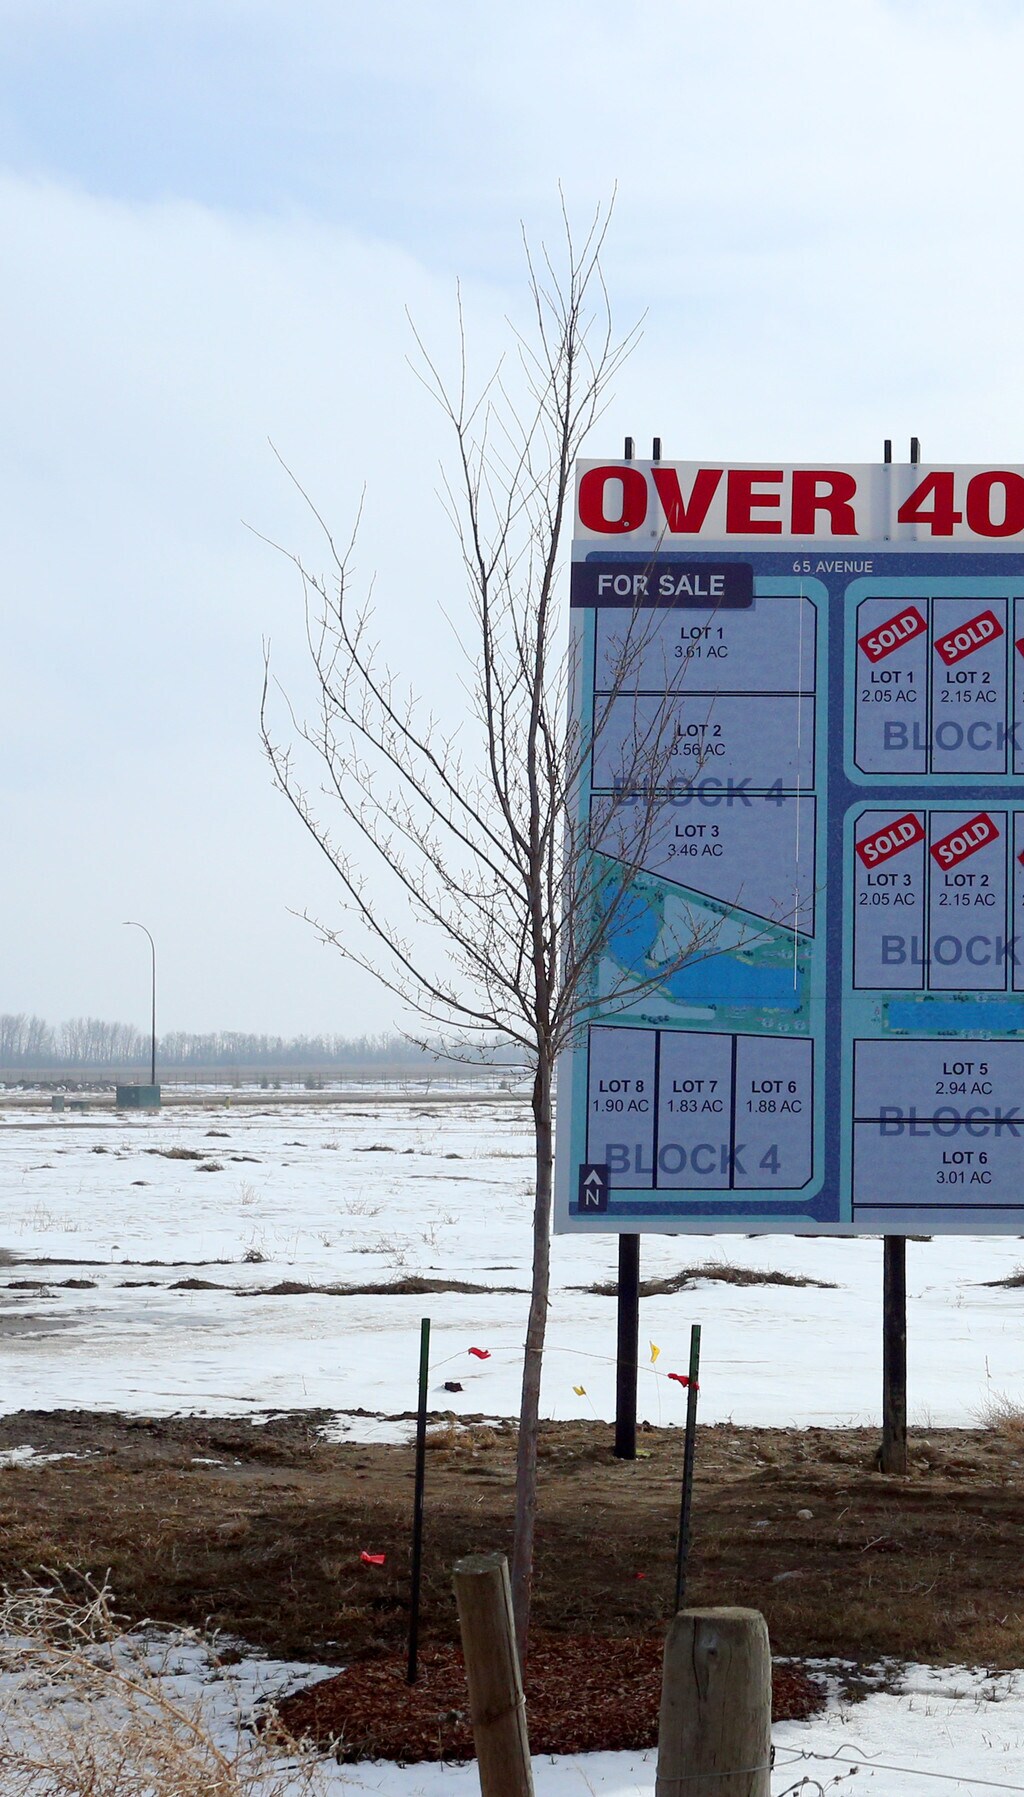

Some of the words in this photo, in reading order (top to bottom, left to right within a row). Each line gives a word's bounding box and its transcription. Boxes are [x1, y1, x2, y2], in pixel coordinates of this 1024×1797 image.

[578, 466, 858, 535] OVER
[793, 561, 811, 573] 65
[815, 561, 873, 573] AVENUE
[598, 574, 649, 596] FOR
[659, 574, 725, 596] SALE
[681, 627, 712, 639] LOT
[716, 627, 723, 639] 1
[866, 615, 918, 656] SOLD
[942, 618, 995, 659] SOLD
[674, 646, 702, 658] 3.61
[706, 646, 728, 658] AC
[870, 671, 903, 684] LOT
[906, 671, 913, 684] 1
[946, 672, 978, 684] LOT
[981, 672, 991, 684] 2
[862, 690, 894, 703] 2.05
[895, 690, 917, 703] AC
[941, 690, 972, 703] 2.15
[976, 690, 997, 703] AC
[678, 725, 708, 736] LOT
[713, 725, 721, 736] 2
[883, 721, 1022, 751] BLOCK
[671, 743, 701, 756] 3.56
[704, 743, 726, 756] AC
[613, 777, 752, 807] BLOCK
[764, 778, 786, 807] 4
[675, 825, 707, 837] LOT
[711, 825, 719, 837] 3
[863, 822, 916, 862] SOLD
[938, 822, 990, 863] SOLD
[668, 844, 698, 857] 3.46
[701, 844, 723, 857] AC
[867, 874, 898, 886] LOT
[903, 874, 912, 886] 3
[945, 874, 976, 887] LOT
[981, 874, 989, 887] 2
[859, 893, 890, 906] 2.05
[892, 893, 915, 906] AC
[939, 893, 970, 907] 2.15
[973, 893, 996, 907] AC
[881, 935, 1022, 966] BLOCK
[943, 1062, 974, 1075] LOT
[979, 1062, 988, 1075] 5
[599, 1080, 630, 1092] LOT
[635, 1080, 644, 1092] 8
[673, 1080, 705, 1093] LOT
[710, 1080, 718, 1093] 7
[751, 1081, 783, 1093] LOT
[788, 1081, 797, 1093] 6
[935, 1082, 967, 1095] 2.94
[970, 1082, 993, 1095] AC
[593, 1100, 623, 1113] 1.90
[627, 1100, 649, 1113] AC
[667, 1100, 697, 1112] 1.83
[701, 1100, 723, 1112] AC
[747, 1100, 776, 1113] 1.88
[780, 1100, 802, 1113] AC
[879, 1106, 1021, 1137] BLOCK
[605, 1143, 748, 1175] BLOCK
[759, 1144, 781, 1175] 4
[942, 1152, 974, 1164] LOT
[979, 1152, 988, 1164] 6
[936, 1171, 965, 1184] 3.01
[970, 1171, 992, 1184] AC
[586, 1189, 599, 1206] N
